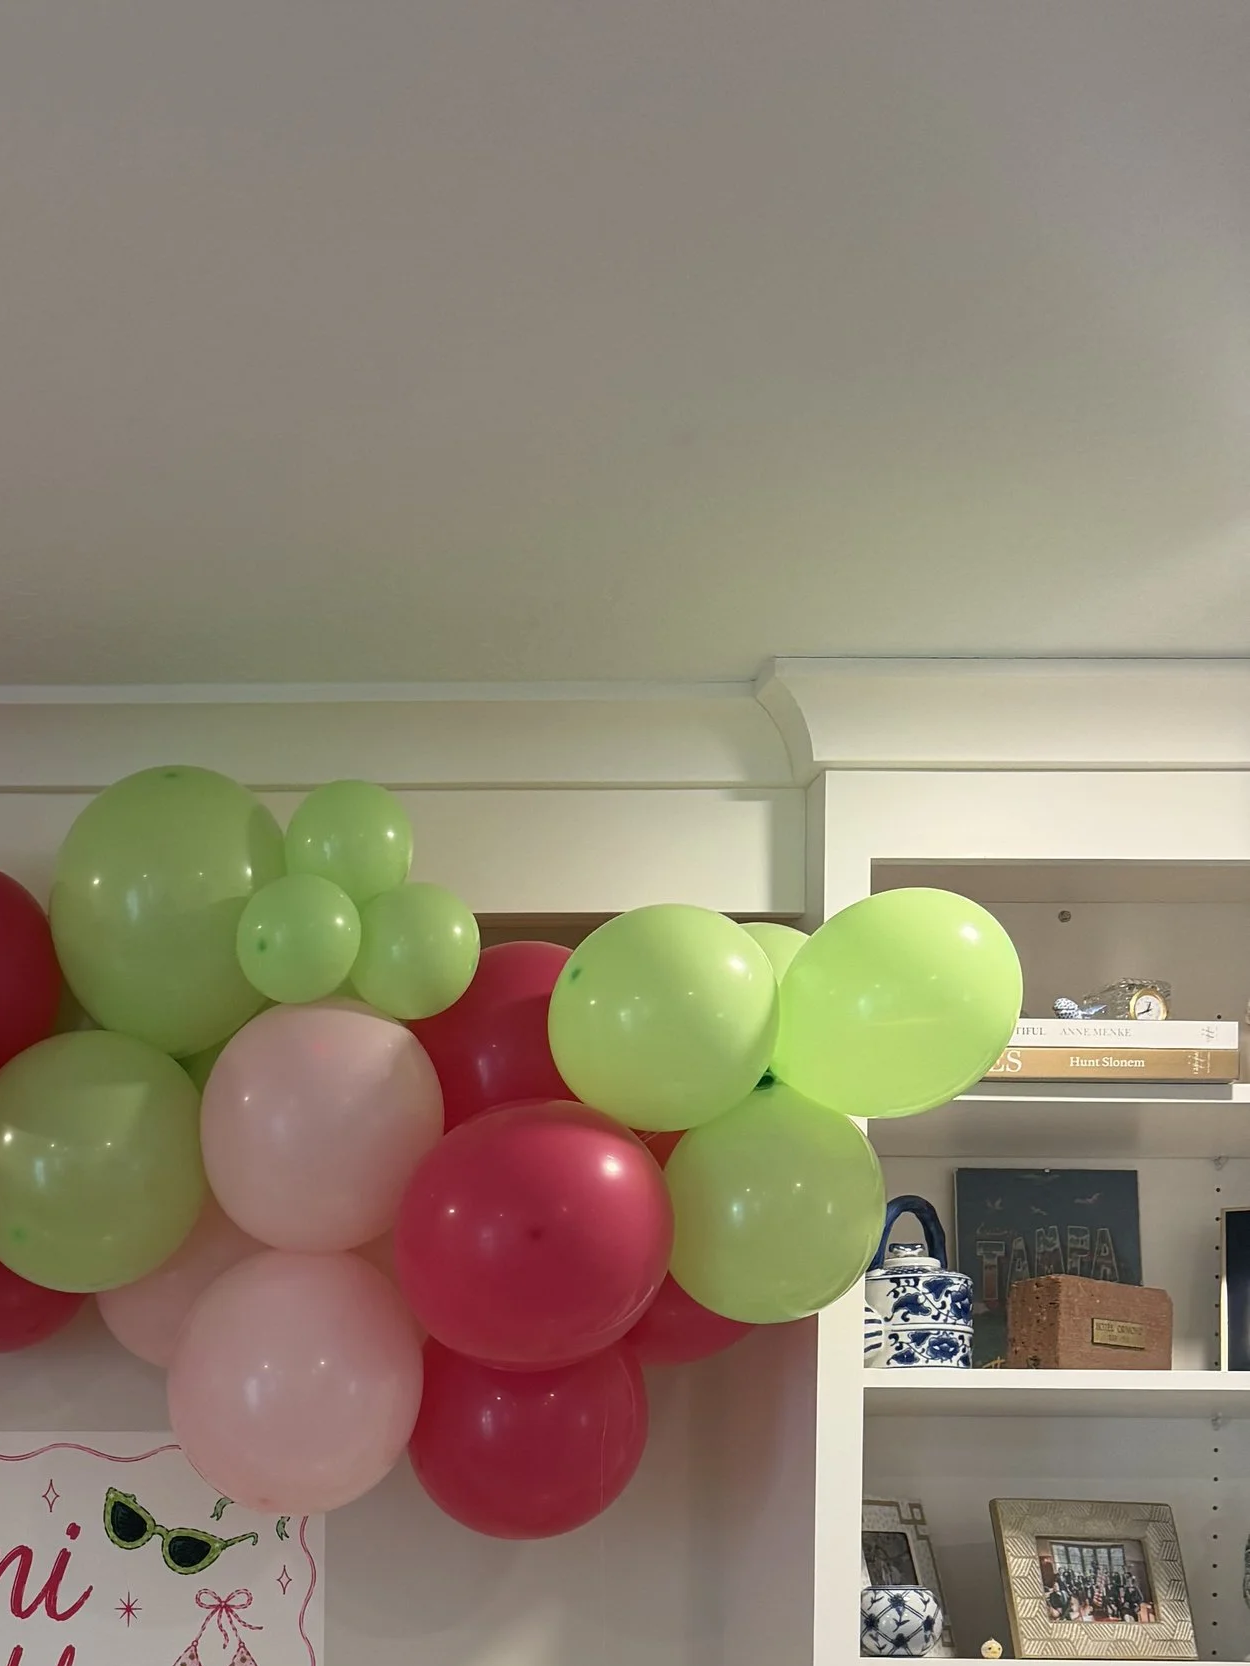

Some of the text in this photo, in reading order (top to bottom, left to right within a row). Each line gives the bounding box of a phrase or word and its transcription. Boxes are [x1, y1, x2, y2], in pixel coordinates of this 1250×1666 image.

[1015, 1026, 1132, 1037] TIFUL ANNE MENKE
[1069, 1056, 1100, 1068] Hunt
[1102, 1056, 1145, 1068] Slonem
[976, 1225, 1120, 1300] TAMPA
